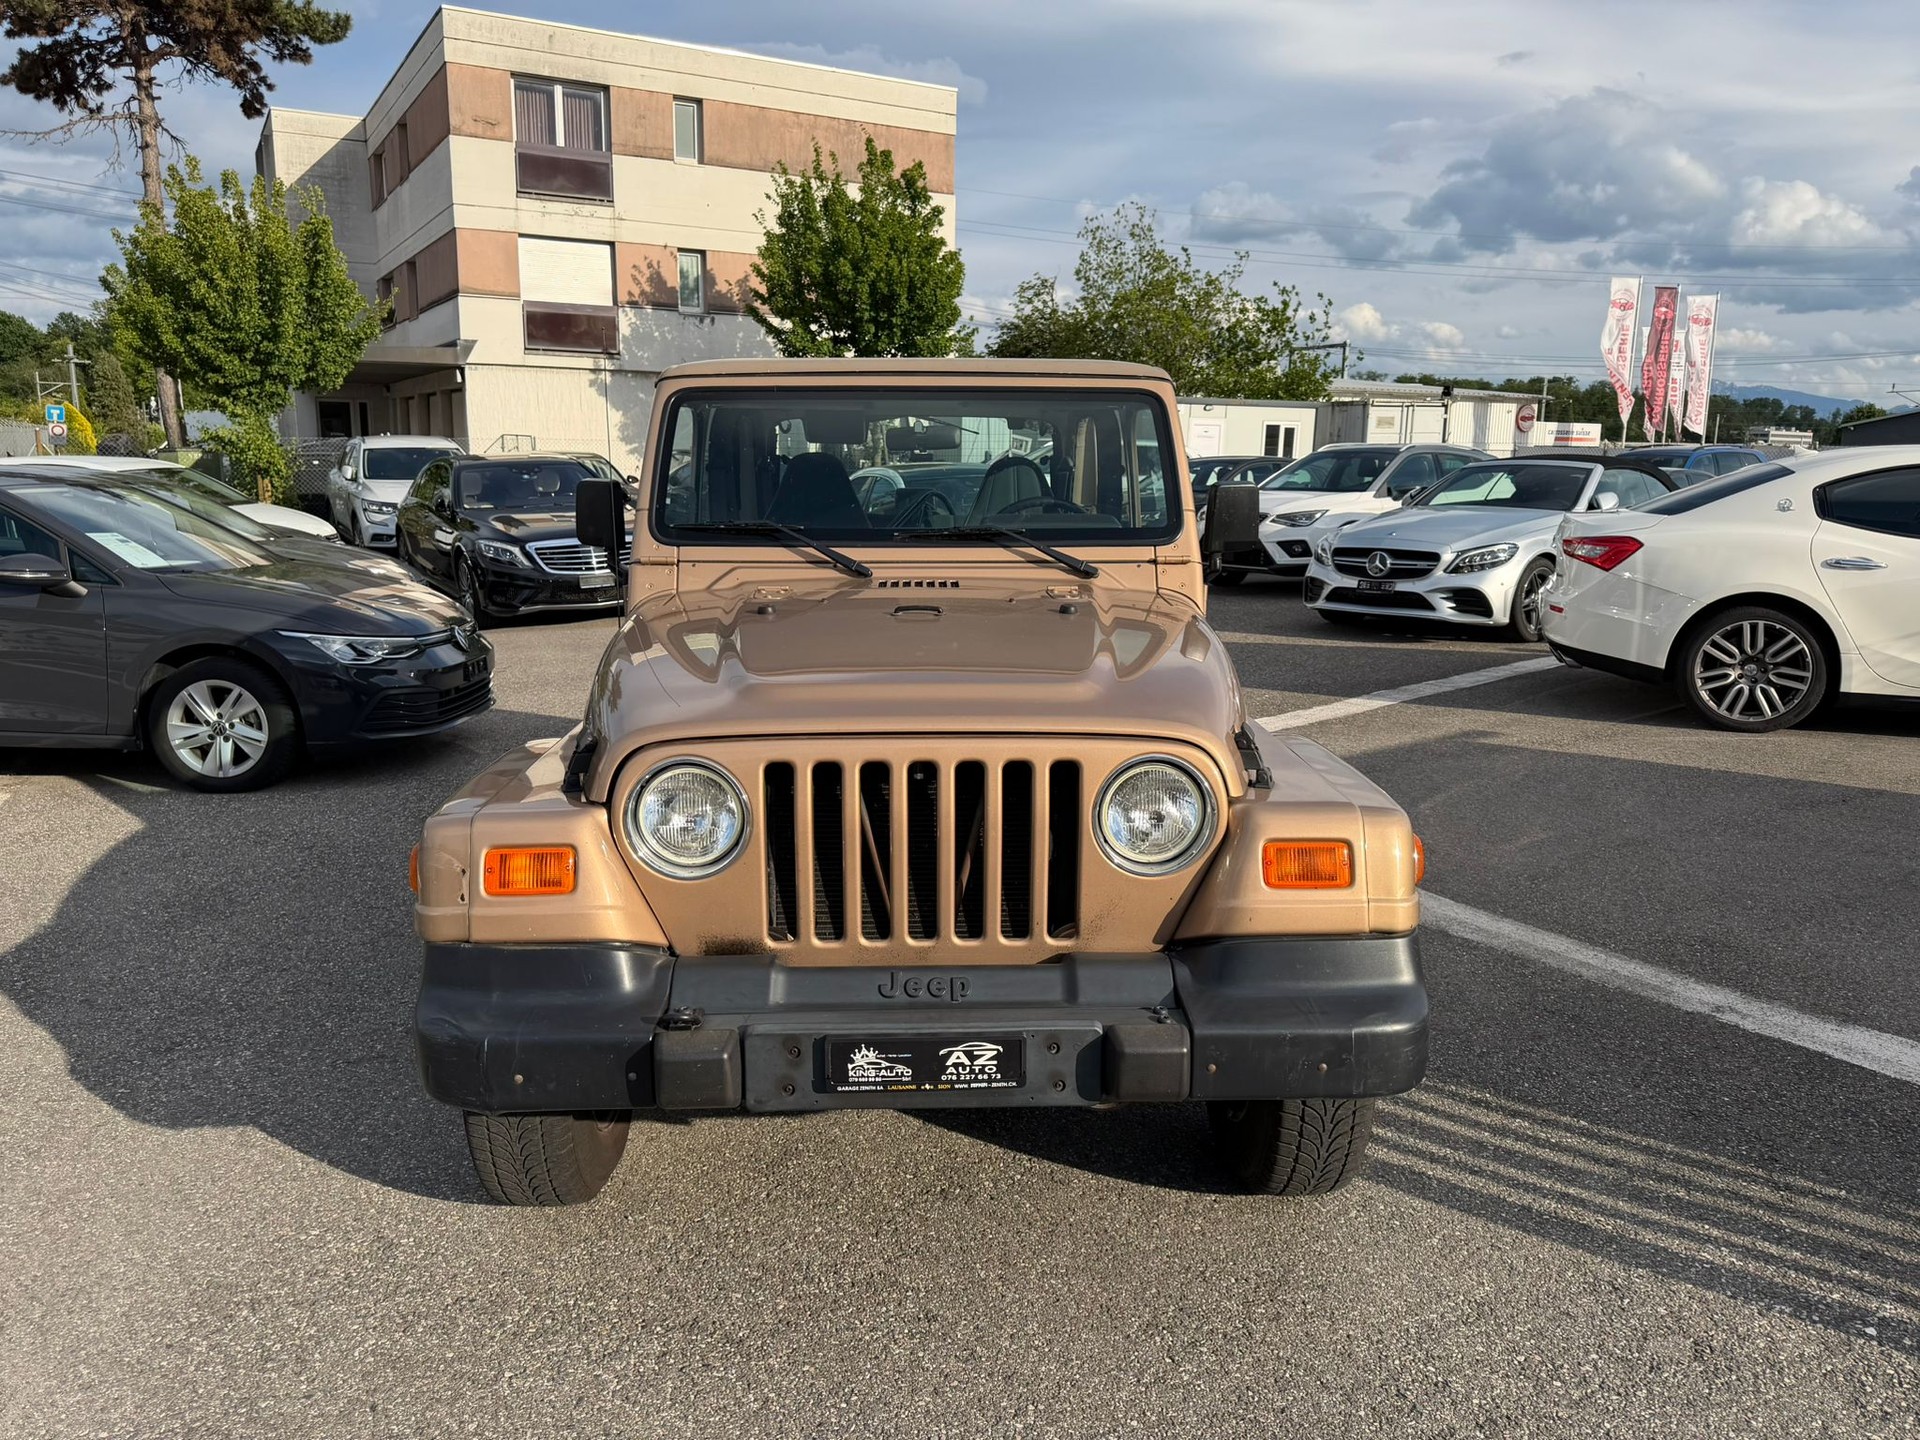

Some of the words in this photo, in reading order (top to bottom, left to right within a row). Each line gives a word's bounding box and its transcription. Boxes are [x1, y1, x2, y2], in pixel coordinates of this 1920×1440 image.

[877, 972, 971, 1002] Jeep
[945, 1050, 998, 1066] AZ
[945, 1065, 997, 1074] AUTO
